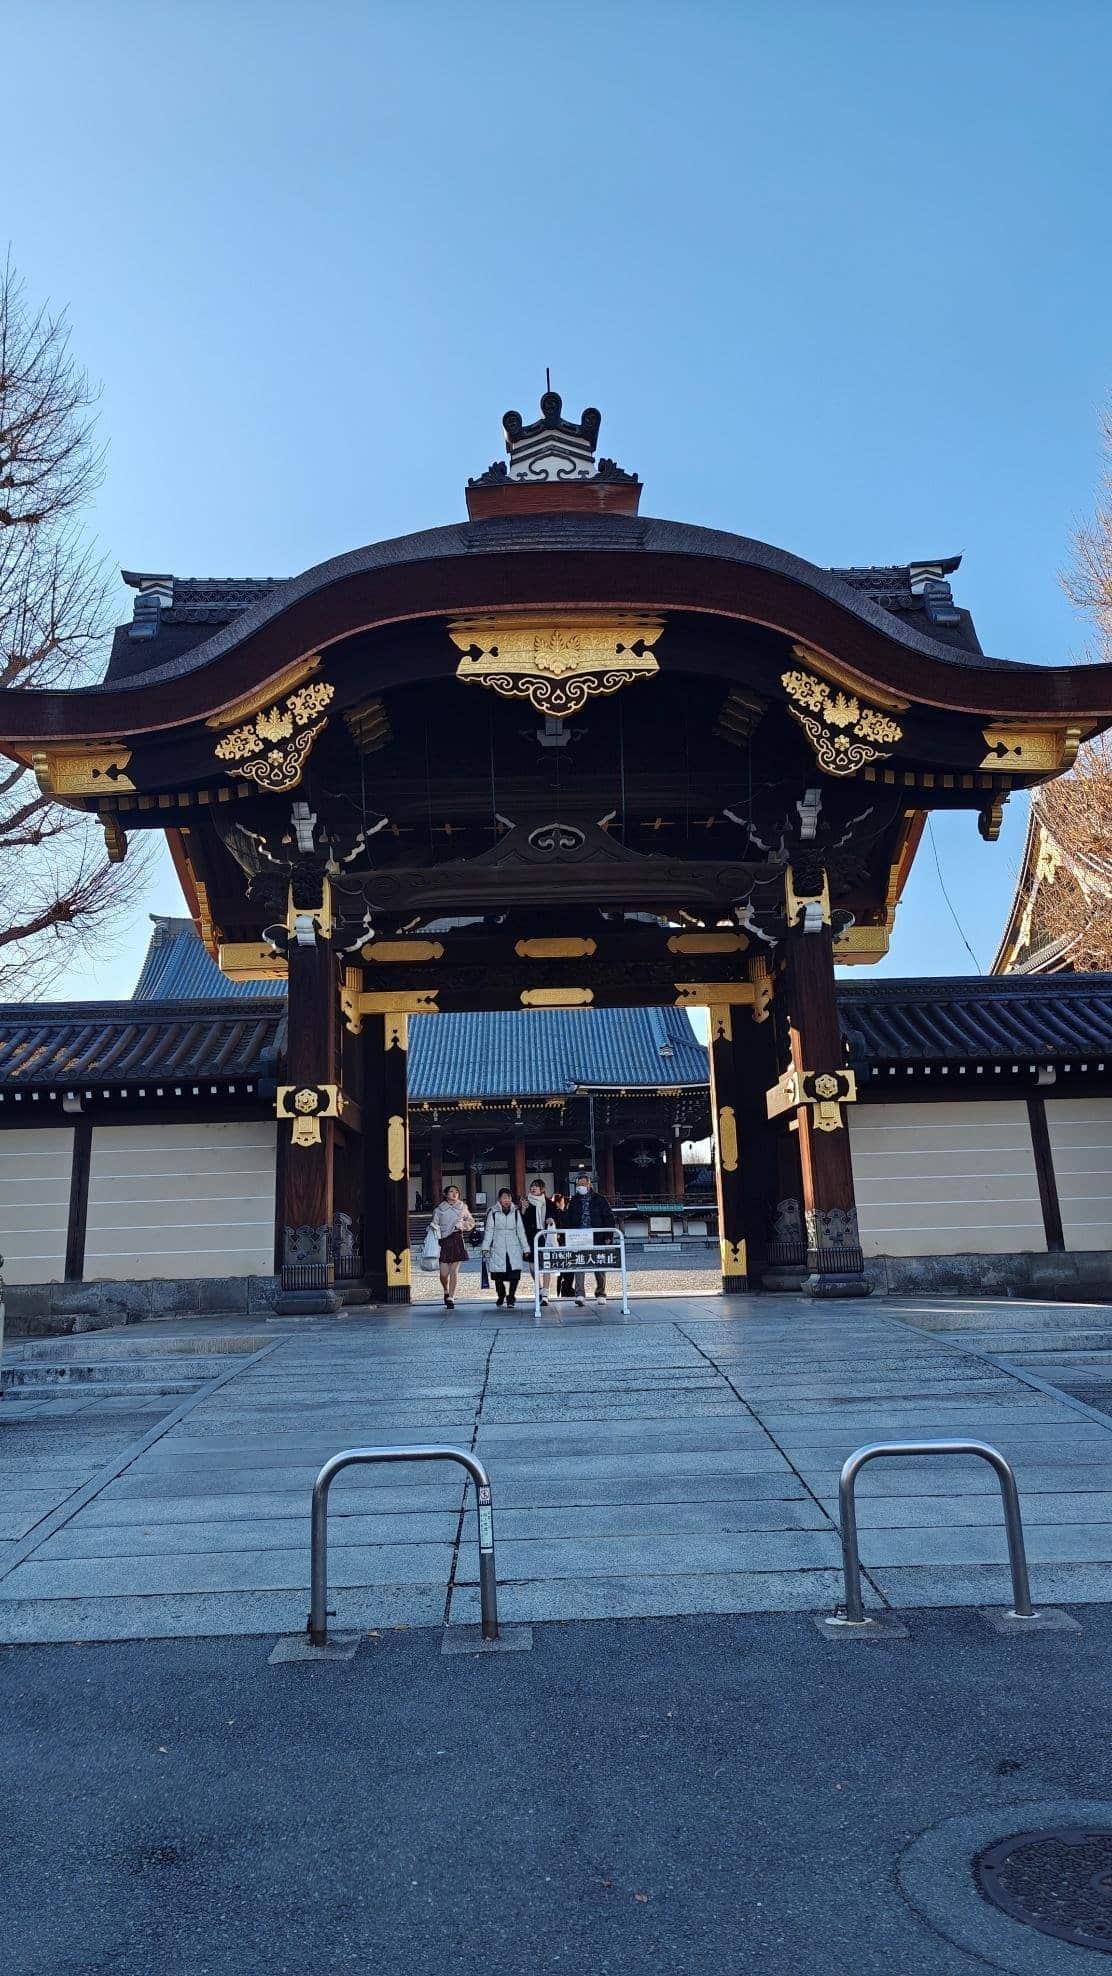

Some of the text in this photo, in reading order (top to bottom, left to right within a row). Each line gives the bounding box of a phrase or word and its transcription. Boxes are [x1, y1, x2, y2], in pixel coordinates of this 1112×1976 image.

[551, 1251, 572, 1260] 自転車
[575, 1253, 616, 1265] 進入禁止
